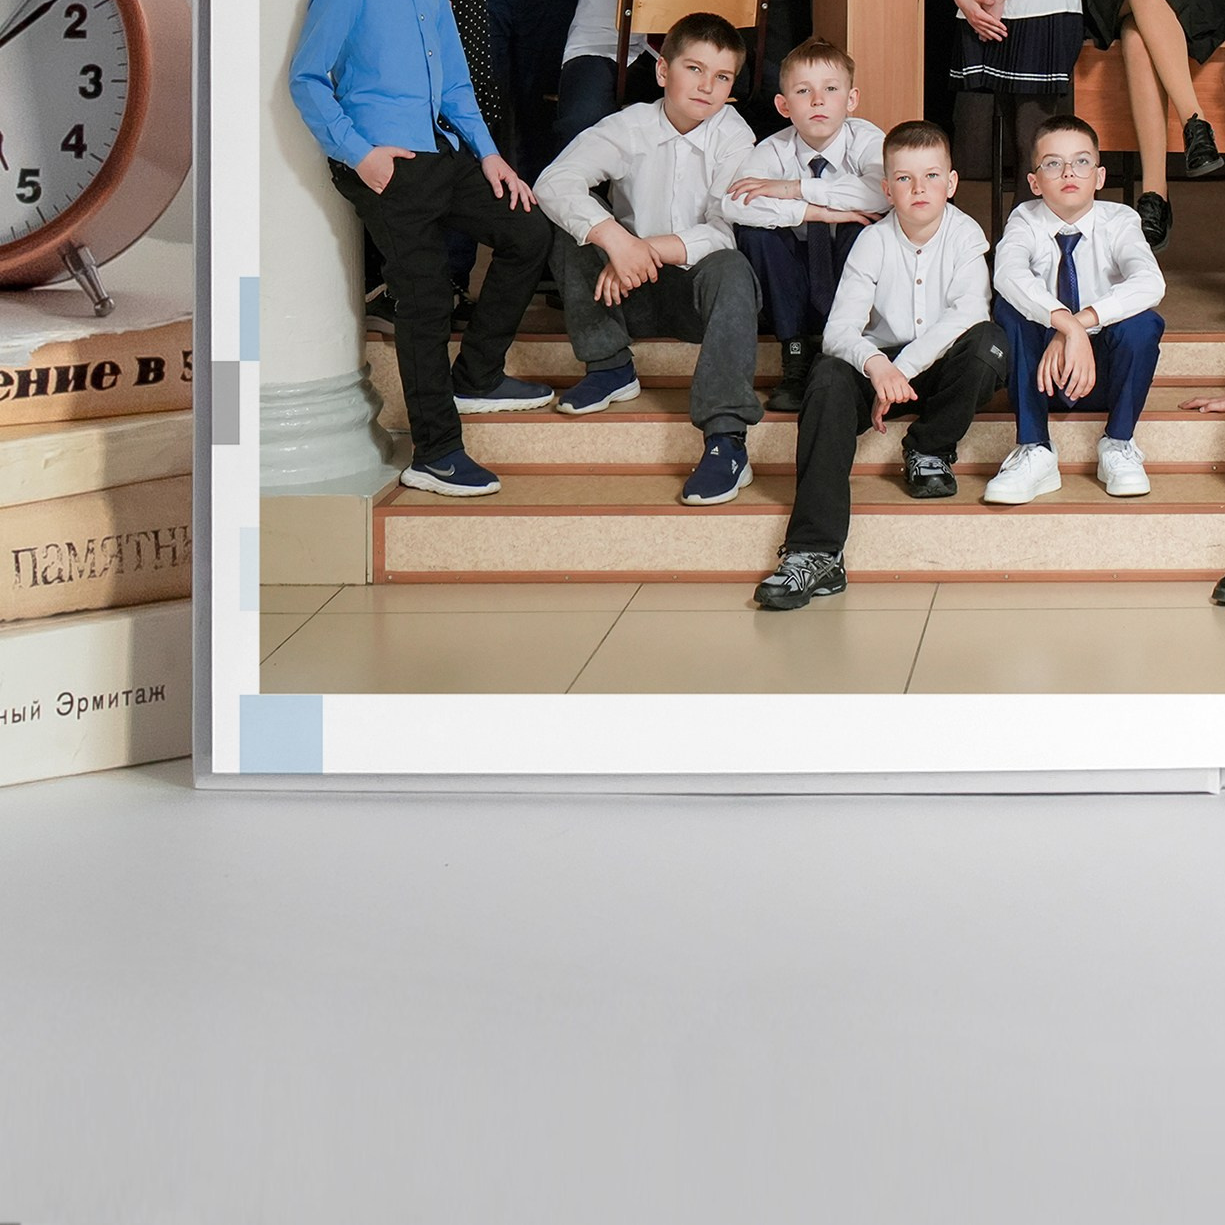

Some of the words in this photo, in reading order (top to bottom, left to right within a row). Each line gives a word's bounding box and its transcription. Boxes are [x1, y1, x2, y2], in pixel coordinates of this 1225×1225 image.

[63, 3, 88, 39] 2
[78, 64, 103, 100] 3
[60, 124, 88, 159] 4
[15, 168, 42, 204] 5
[56, 684, 166, 720] Эрмитаж
